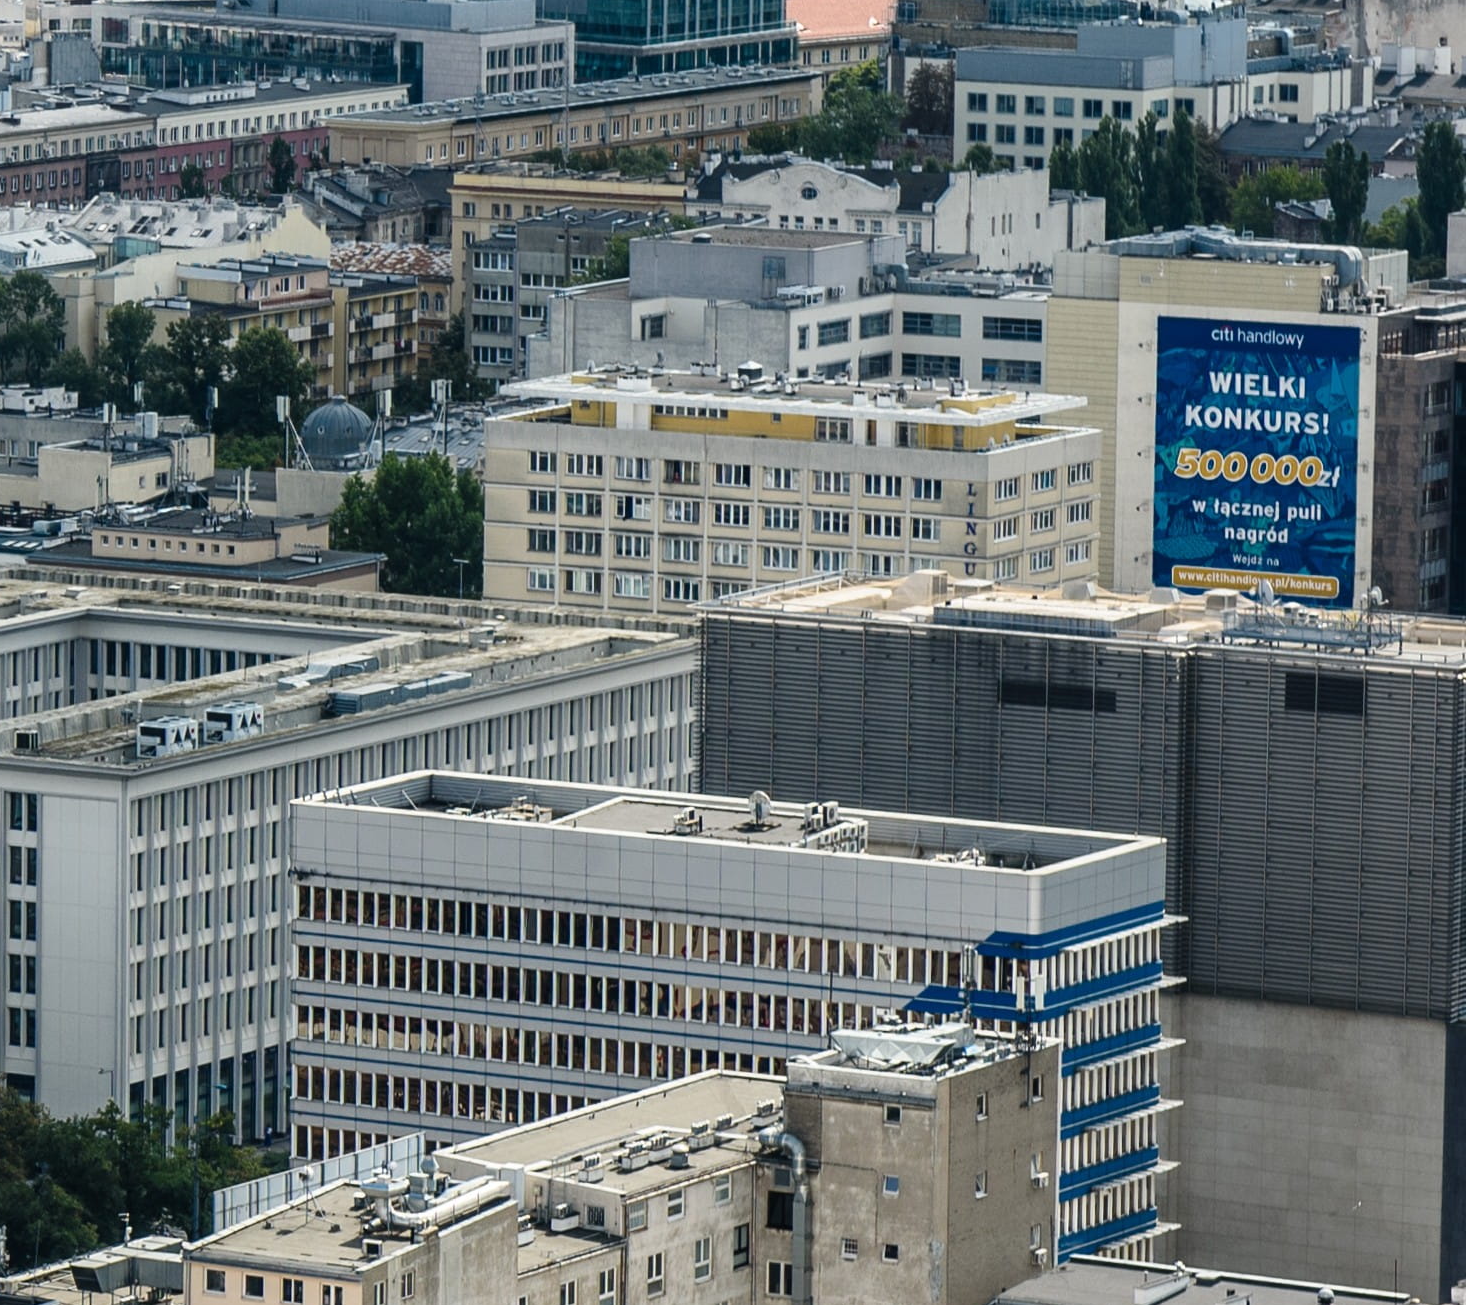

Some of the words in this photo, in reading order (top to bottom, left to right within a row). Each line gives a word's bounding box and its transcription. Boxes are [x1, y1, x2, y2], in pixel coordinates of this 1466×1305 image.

[1211, 325, 1233, 342] citi
[1237, 328, 1304, 349] handlowy
[1208, 371, 1306, 399] WIELKI
[1185, 405, 1329, 435] KONKURS!
[1174, 447, 1247, 482] 500
[1192, 500, 1206, 513] w
[1213, 498, 1279, 522] łącznej
[1287, 504, 1323, 525] puli
[1224, 526, 1288, 545] nagród
[1267, 556, 1280, 567] na
